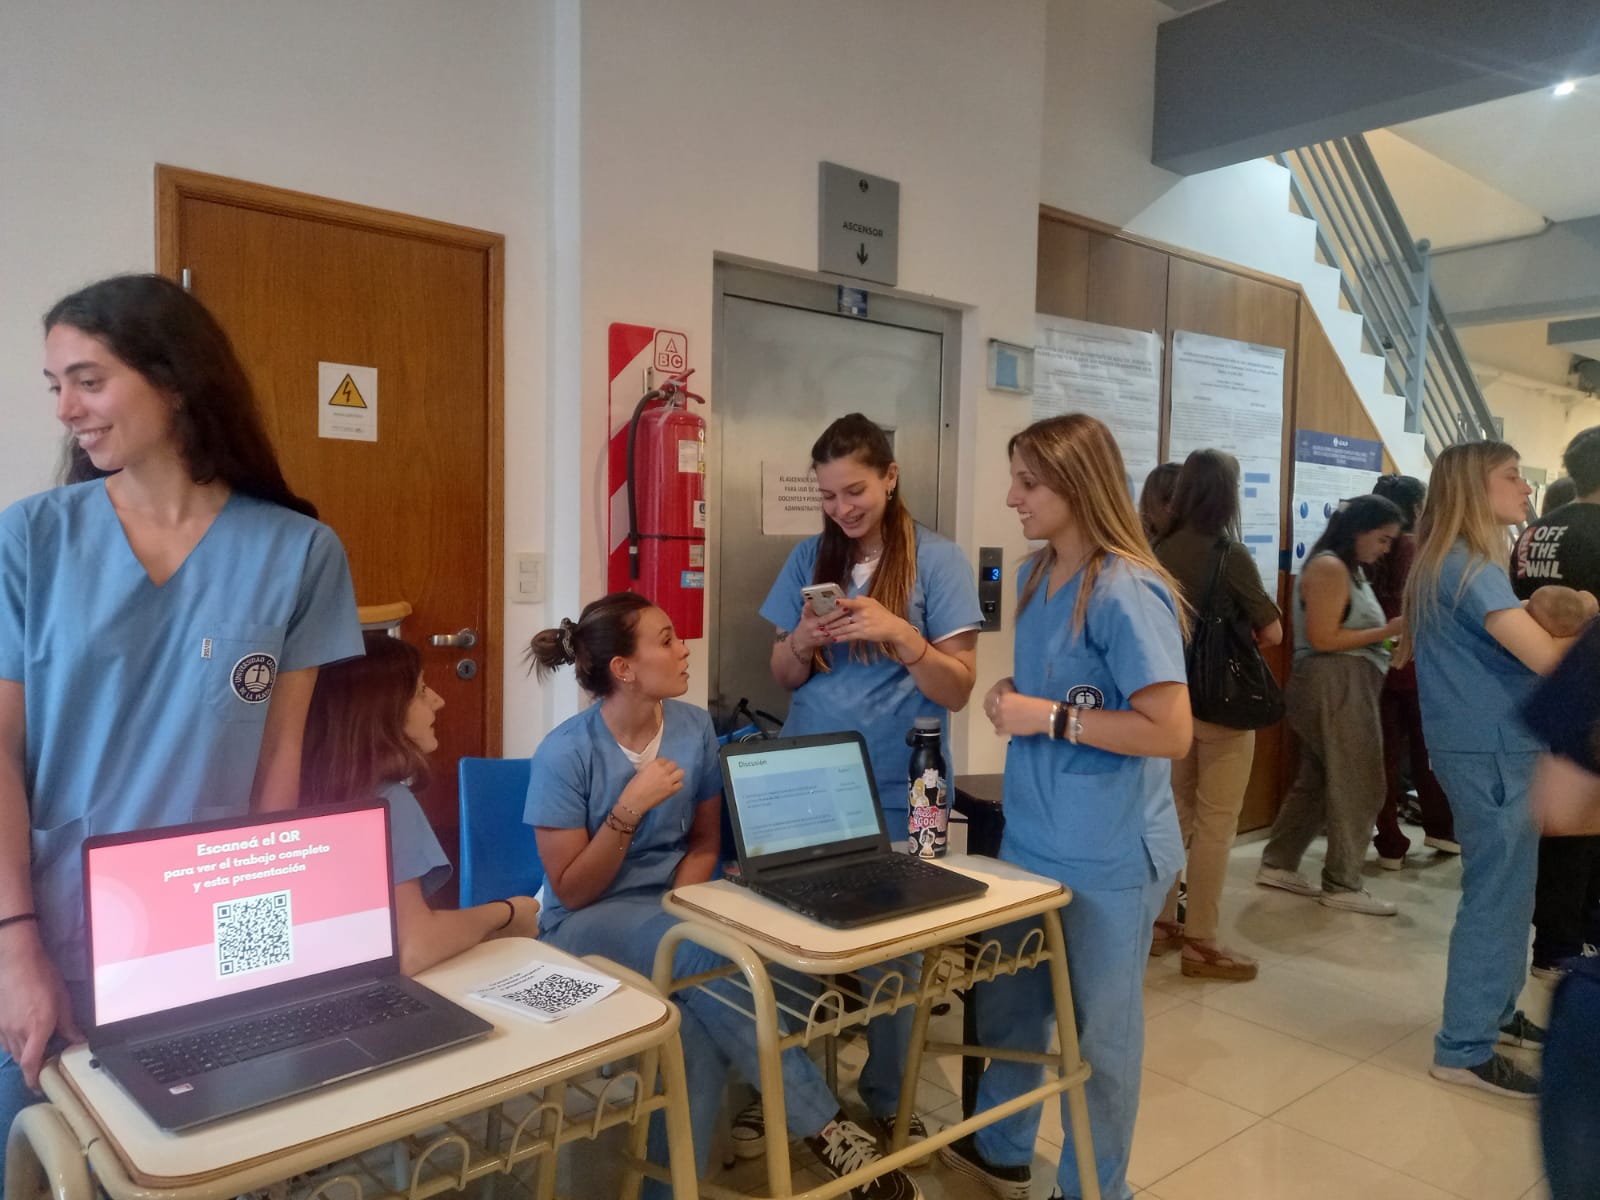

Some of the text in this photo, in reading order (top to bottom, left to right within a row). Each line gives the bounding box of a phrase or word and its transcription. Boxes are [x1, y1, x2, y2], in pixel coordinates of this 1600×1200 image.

[842, 221, 883, 237] ASCENSOR
[665, 337, 678, 353] A
[1533, 525, 1569, 542] OFF
[1529, 542, 1561, 559] THE
[991, 568, 1000, 580] 3
[738, 759, 768, 768] Discusión
[196, 830, 301, 857] Escaneá el QR
[163, 844, 331, 882] para ver el trabajo completo
[192, 864, 306, 893] y esta presentación
